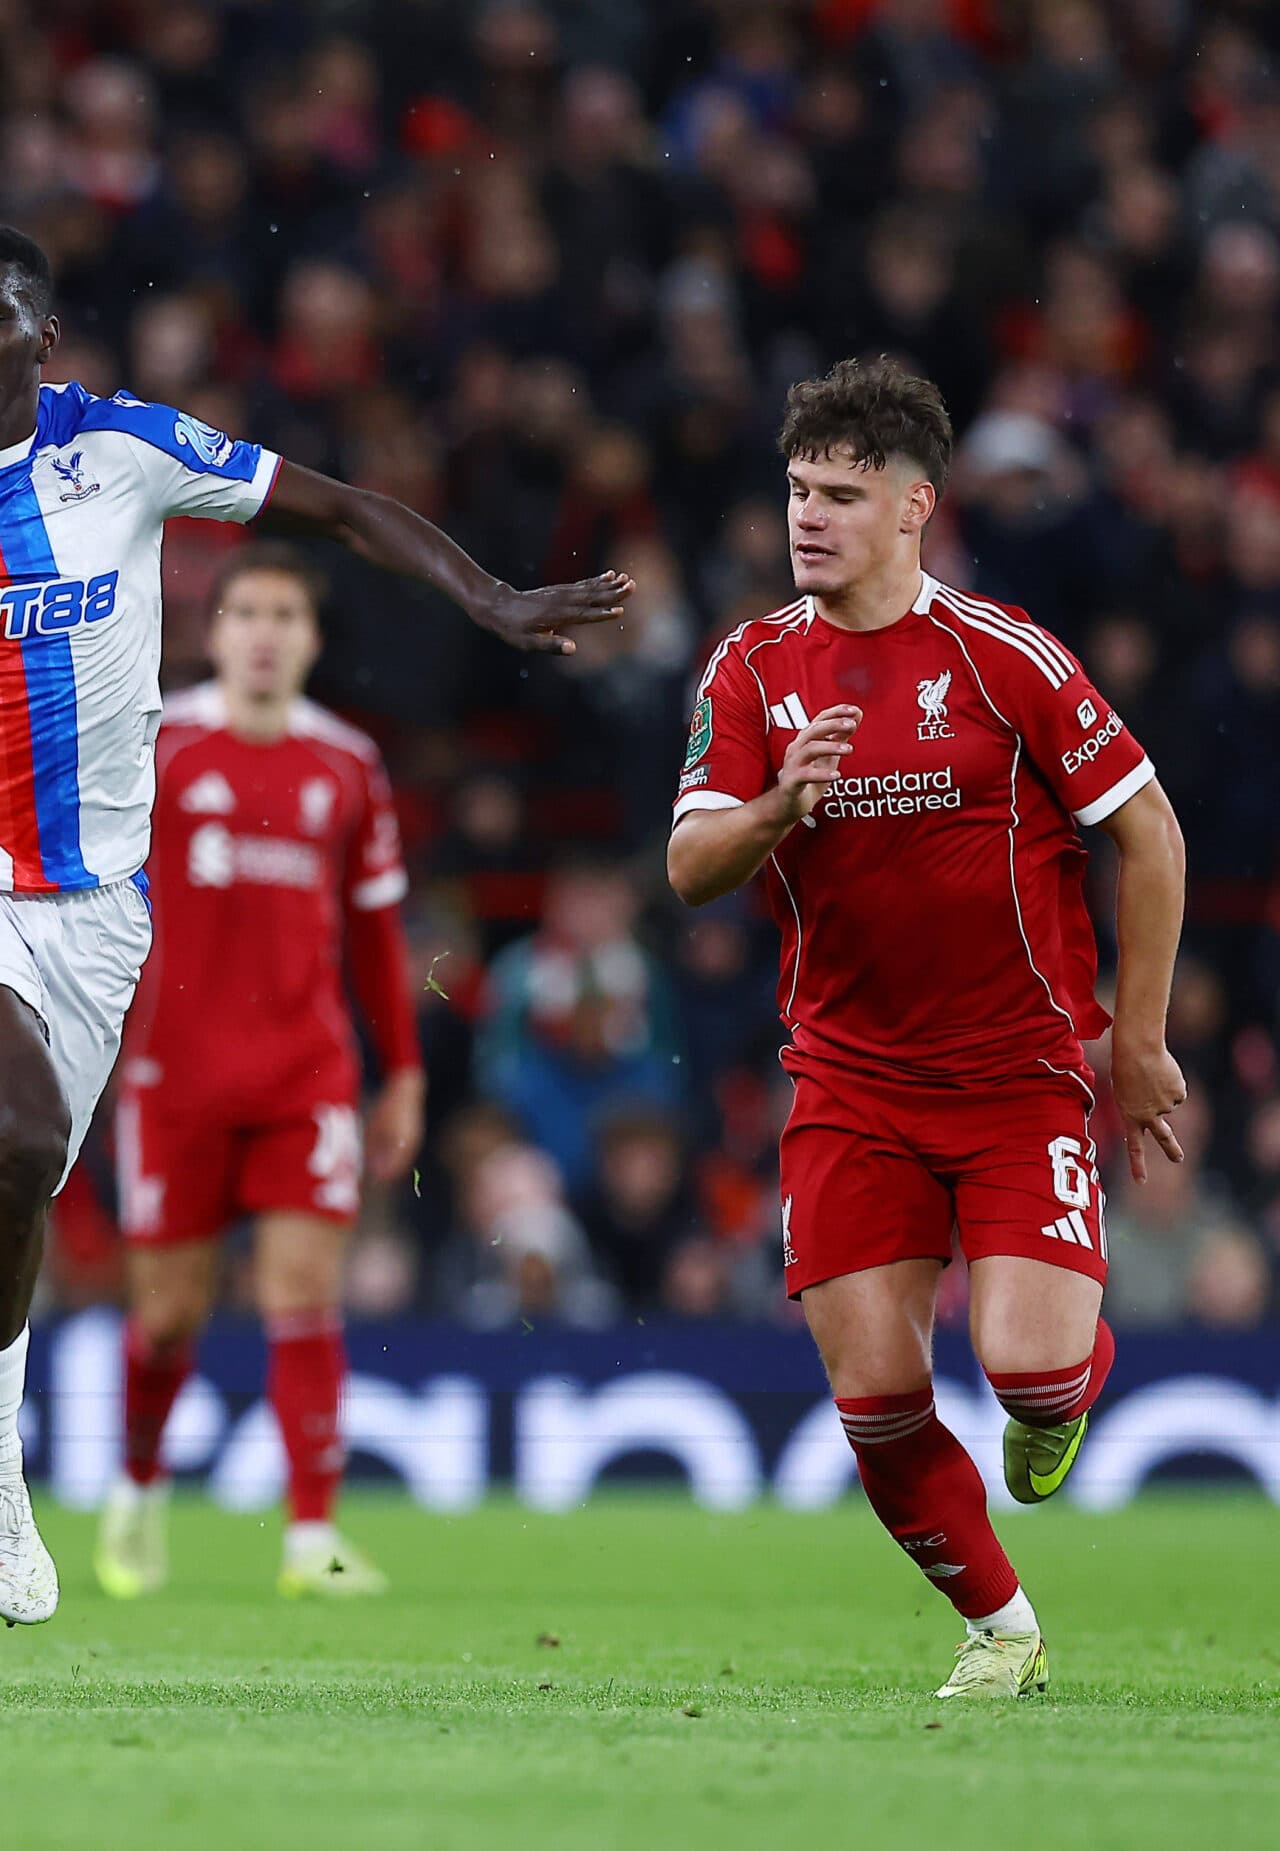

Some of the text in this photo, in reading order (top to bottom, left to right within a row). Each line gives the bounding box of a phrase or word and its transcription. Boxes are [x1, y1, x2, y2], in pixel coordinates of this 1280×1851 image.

[1061, 710, 1123, 775] Expedi
[824, 788, 962, 818] chartered
[1047, 1135, 1091, 1211] 6
